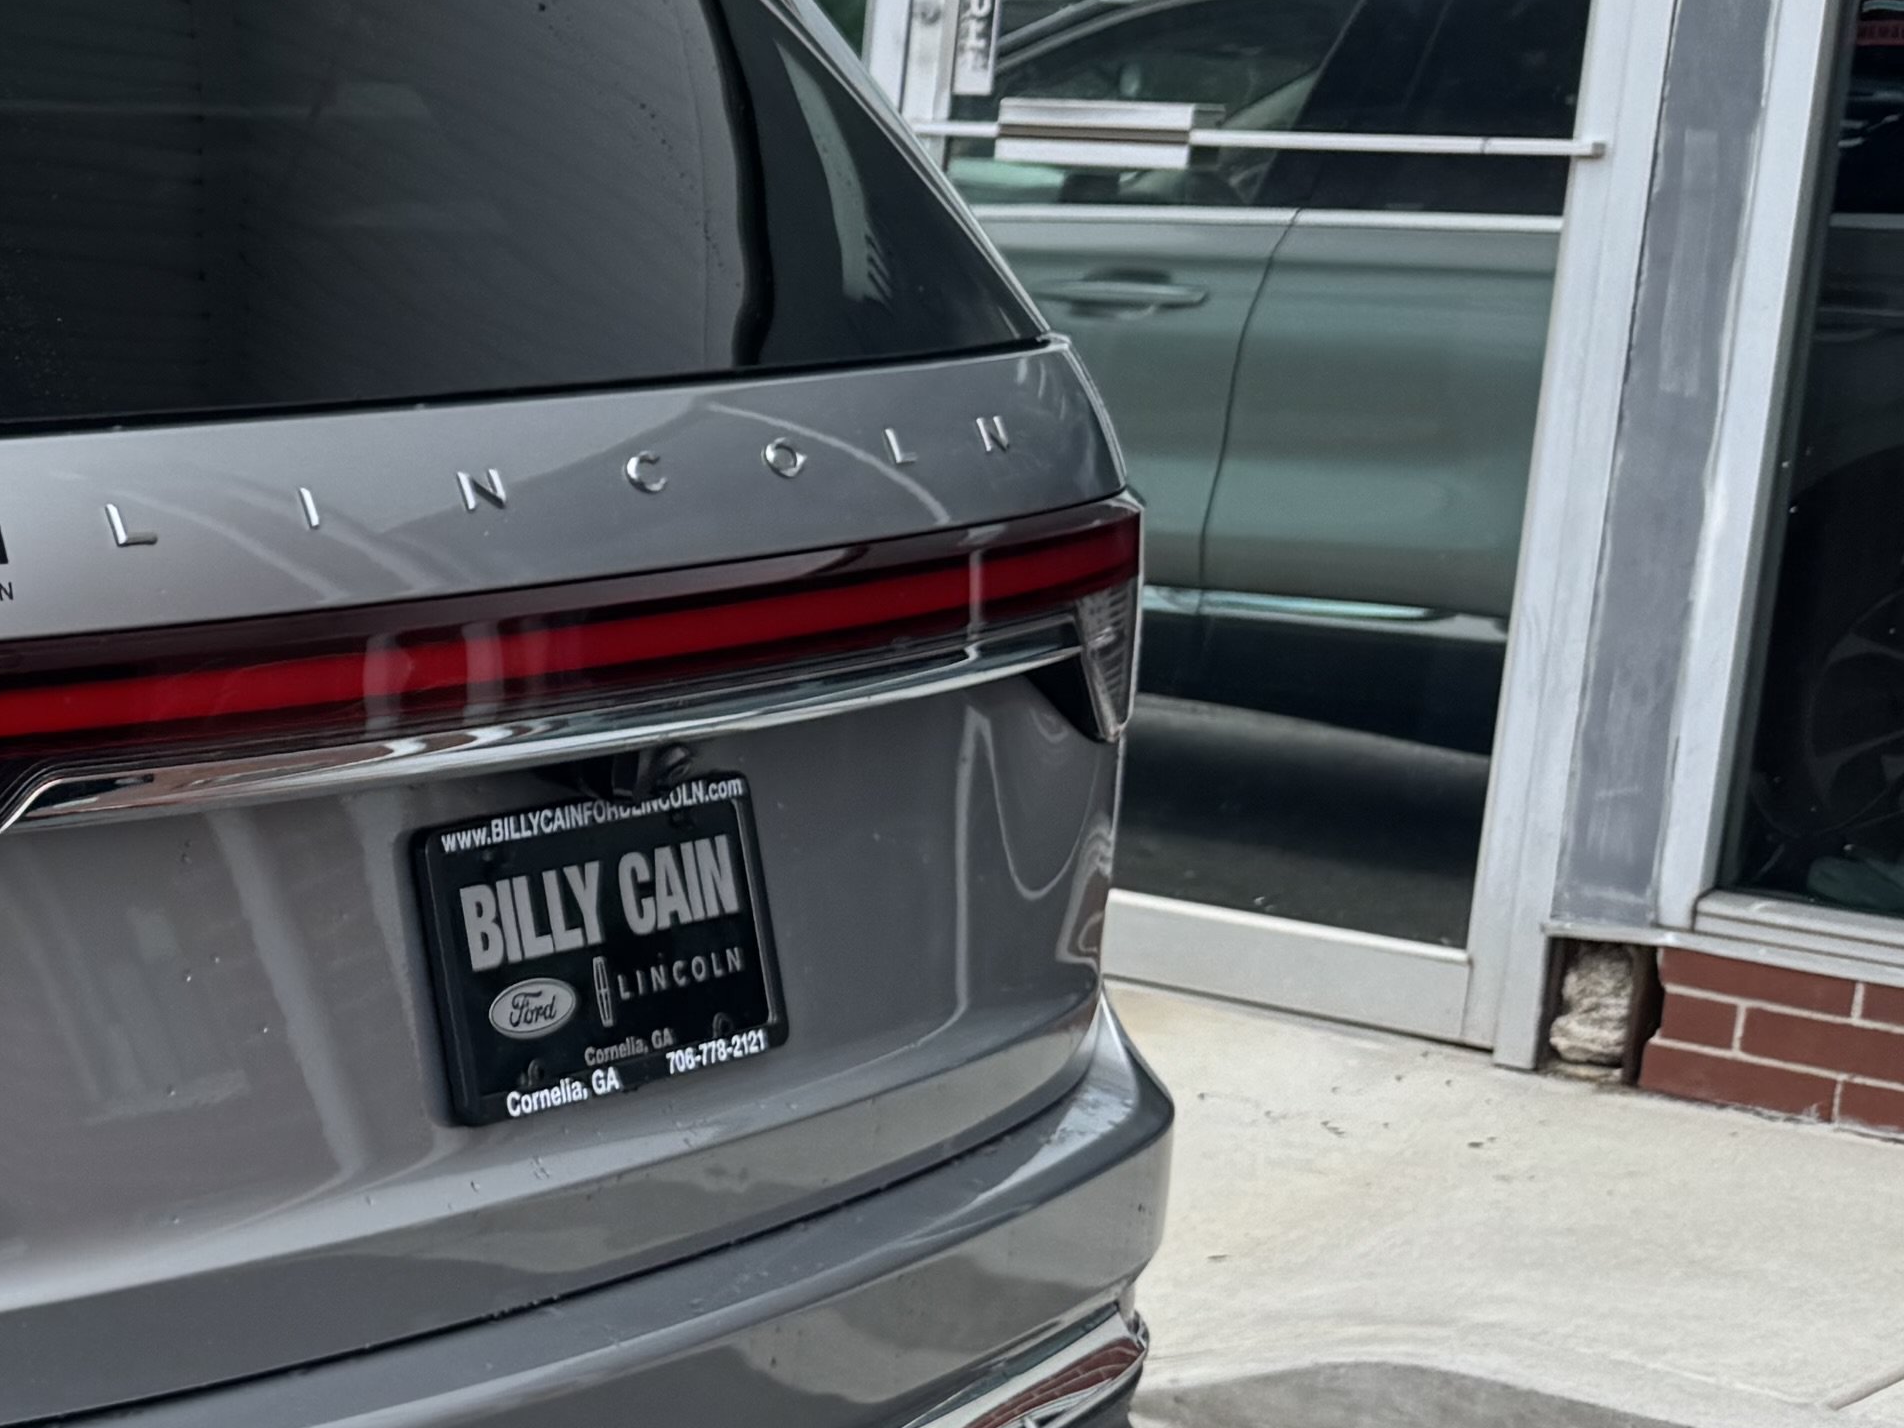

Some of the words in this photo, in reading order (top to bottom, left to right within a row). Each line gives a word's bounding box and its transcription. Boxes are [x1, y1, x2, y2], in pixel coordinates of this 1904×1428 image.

[105, 415, 1010, 547] LINCOLN
[459, 860, 603, 971] BILLY
[618, 834, 739, 935] CAIN
[617, 946, 743, 1001] LINCOLN
[506, 1079, 588, 1118] Cornelia,
[591, 1066, 621, 1095] GA
[665, 1028, 767, 1075] 706-778-2121
[584, 1035, 648, 1067] Cornelia,
[651, 1027, 674, 1049] GA
